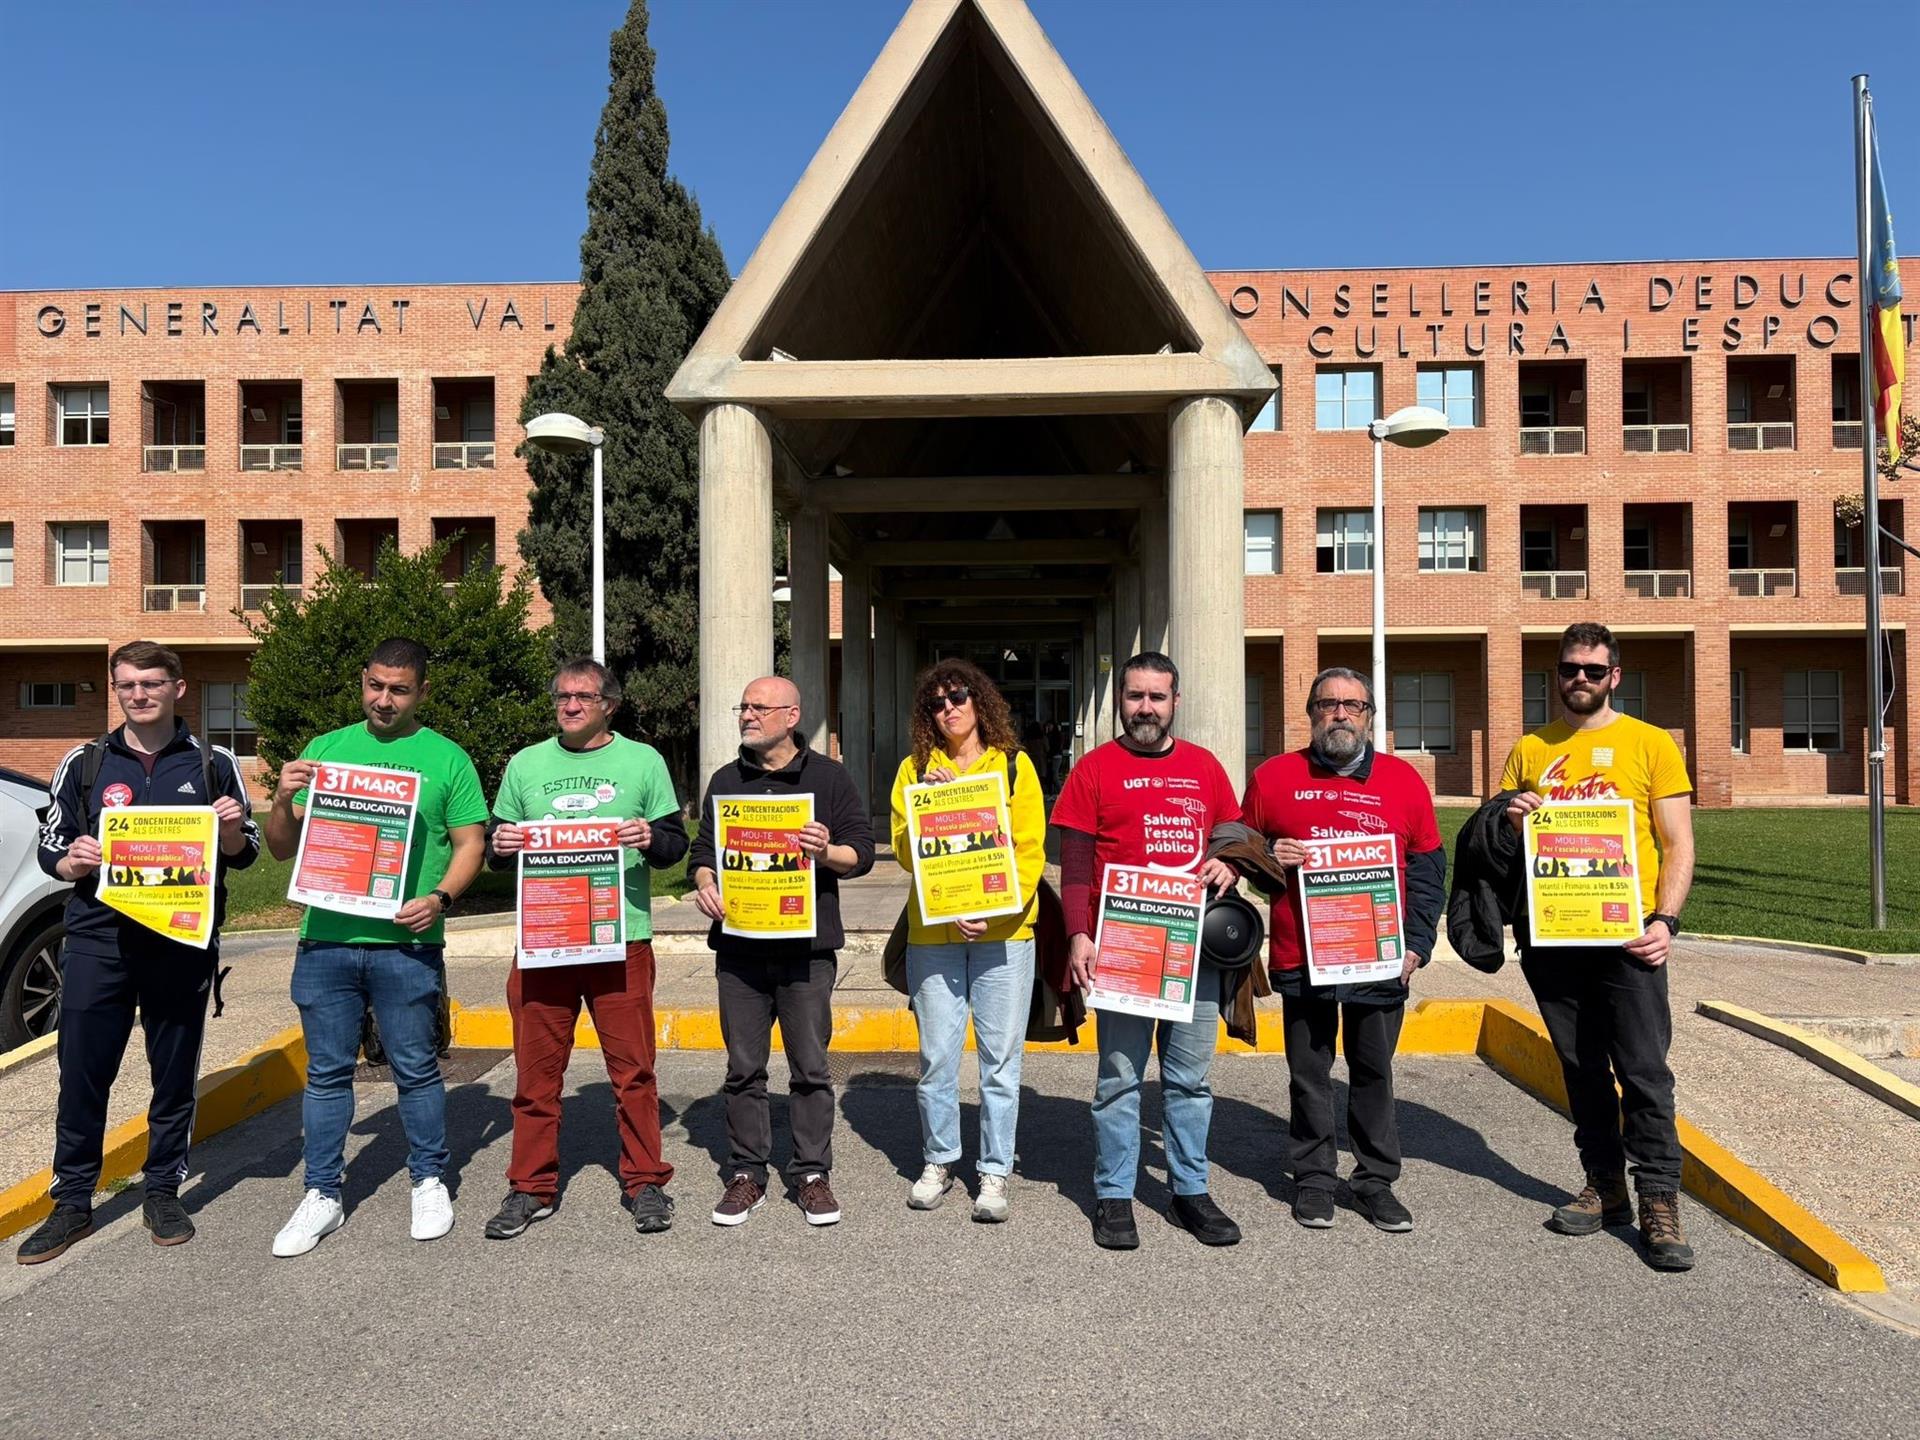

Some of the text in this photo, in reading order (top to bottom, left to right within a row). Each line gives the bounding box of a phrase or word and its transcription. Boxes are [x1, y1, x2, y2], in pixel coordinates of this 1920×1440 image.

[1230, 273, 1854, 320] ONSELLERIA D'EDUC
[37, 297, 555, 338] GENERALITAT VAL
[1308, 314, 1918, 358] CULTURA I ESPOT
[1546, 754, 1571, 781] la
[323, 768, 409, 799] 31 MARÇ
[1123, 778, 1151, 789] UGT
[1549, 772, 1620, 800] nostra
[913, 783, 989, 807] 24 CONCENTRACIONS
[934, 794, 975, 807] ALS CENTRES
[1294, 790, 1323, 800] UGT
[319, 797, 406, 816] VAGA EDUCATIVA
[722, 804, 800, 818] 24 CONCENTRACIONS
[108, 817, 202, 831] 24 CONCENTRACIONS
[742, 814, 784, 822] ALS CENTRES
[1143, 813, 1192, 826] Salvem
[1532, 811, 1617, 825] 24 CONCENTRACIONS
[1555, 820, 1600, 828] ALS CENTRES
[133, 826, 182, 834] ALS CENTRES
[1144, 827, 1195, 840] l'escola
[1310, 826, 1366, 838] Salvem
[528, 827, 612, 848] 31 MARÇ
[1146, 840, 1195, 855] pública
[528, 853, 614, 865] VAGA EDUCATIVA
[977, 855, 987, 863] les
[987, 852, 1005, 861] 8.55h
[1308, 845, 1387, 868] 31 MARÇ
[788, 875, 806, 884] 8.55h
[1309, 870, 1391, 884] VAGA EDUCATIVA
[1114, 872, 1197, 901] 31 MARÇ
[1598, 882, 1609, 890] les
[1609, 882, 1629, 890] 8.55h
[173, 890, 183, 898] les
[184, 890, 204, 899] 8.55h
[1111, 899, 1195, 918] VAGA EDUCATIVA
